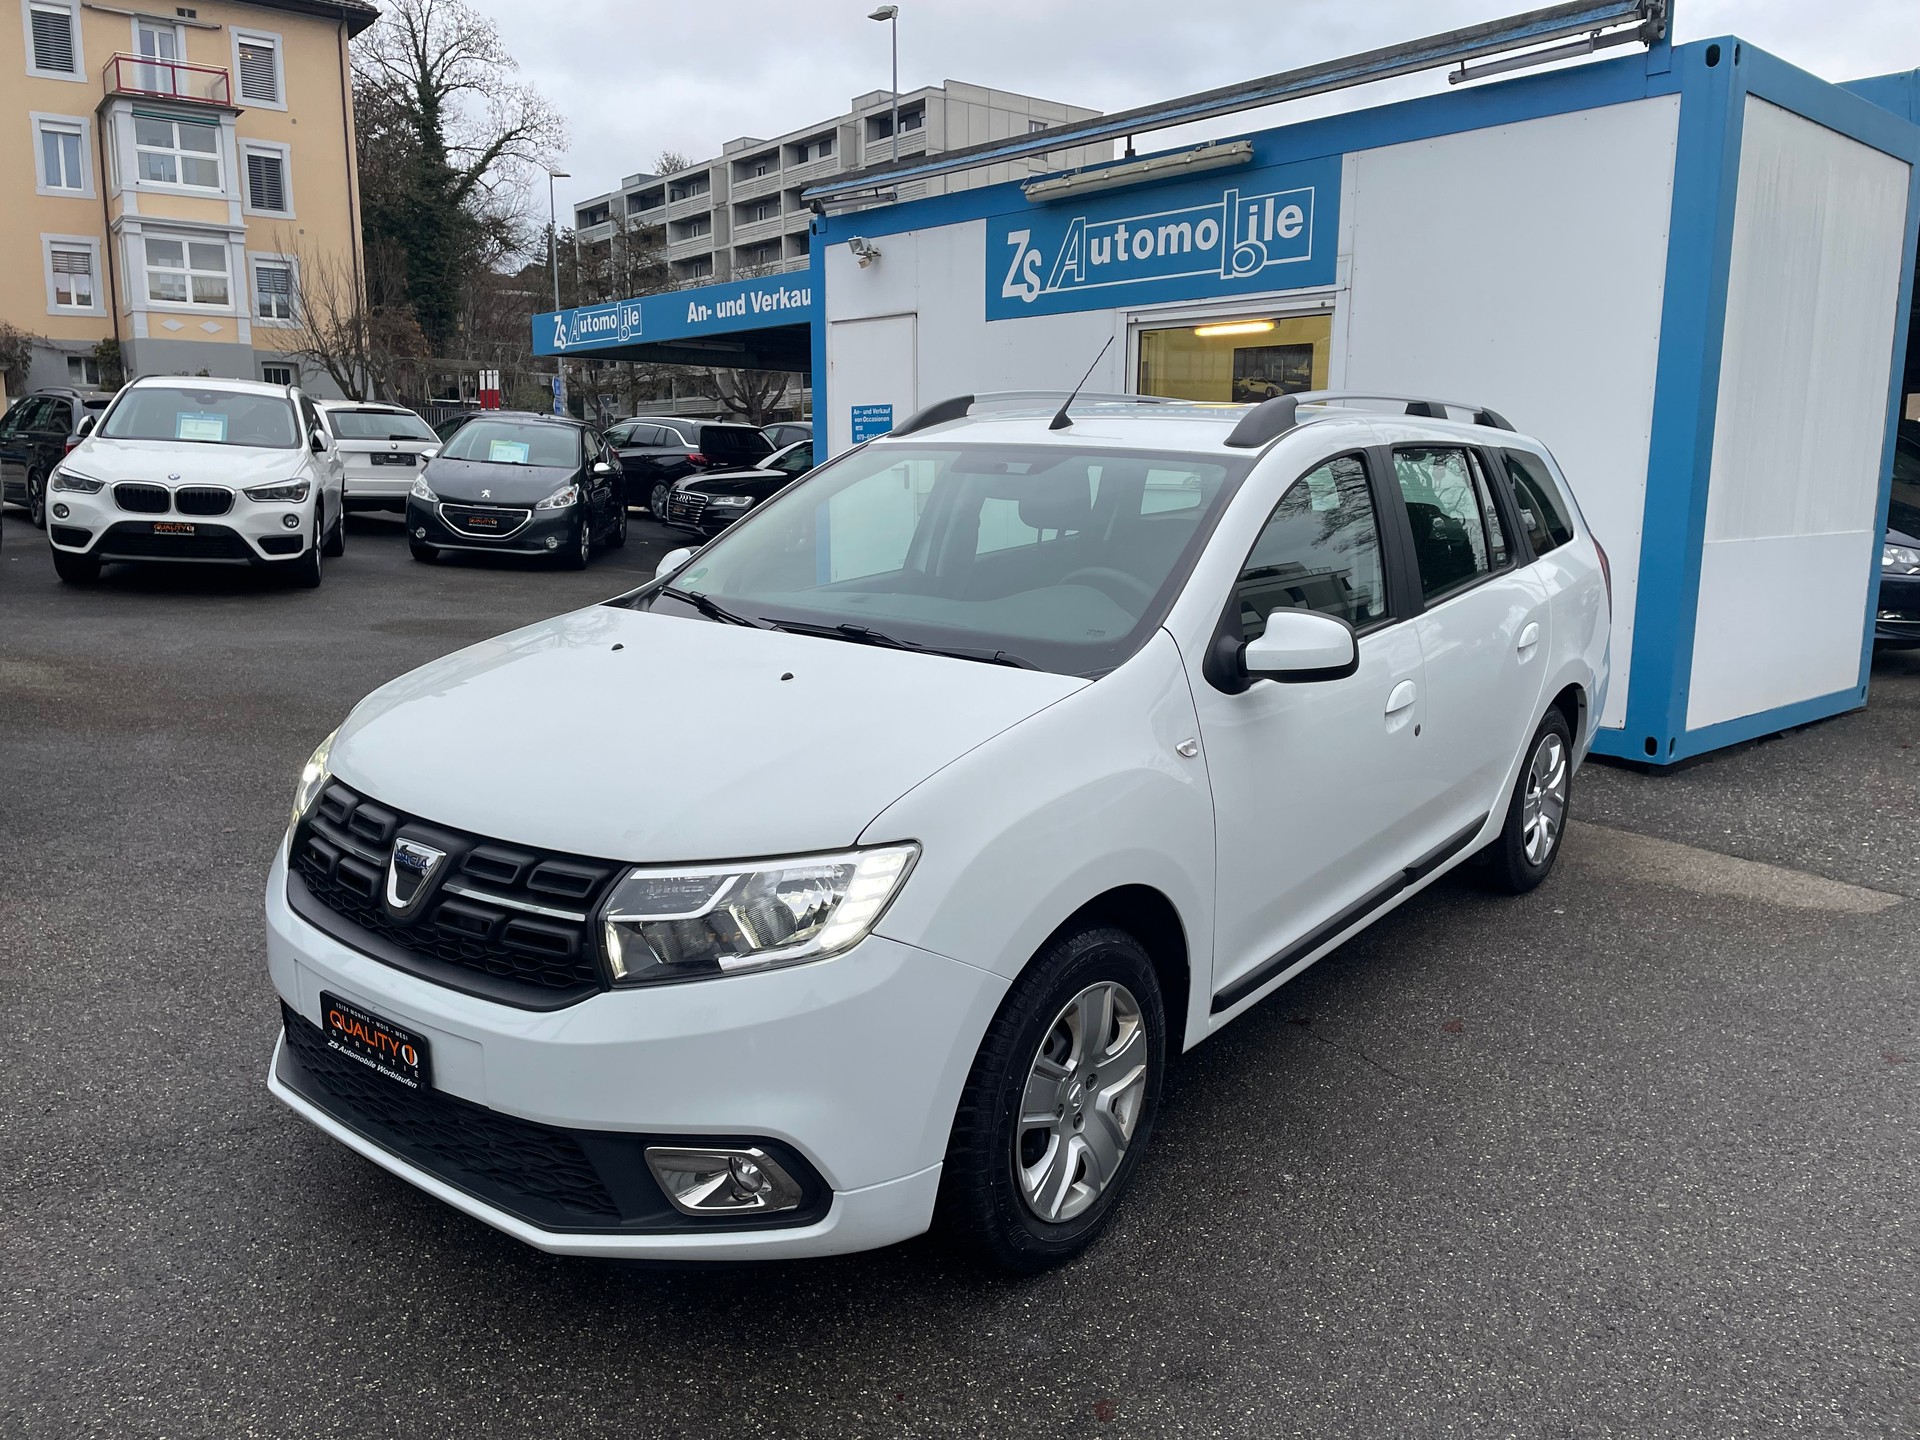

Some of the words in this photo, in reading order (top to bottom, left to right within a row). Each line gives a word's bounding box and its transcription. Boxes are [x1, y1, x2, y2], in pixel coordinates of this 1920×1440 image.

[1046, 188, 1304, 291] Automobile
[568, 303, 640, 343] Automobile
[687, 301, 713, 324] An-
[716, 292, 746, 319] und
[750, 286, 812, 315] Verkau
[330, 1010, 399, 1056] QUALITY
[338, 1045, 377, 1069] Automobile
[377, 1064, 418, 1089] Worblaufen
